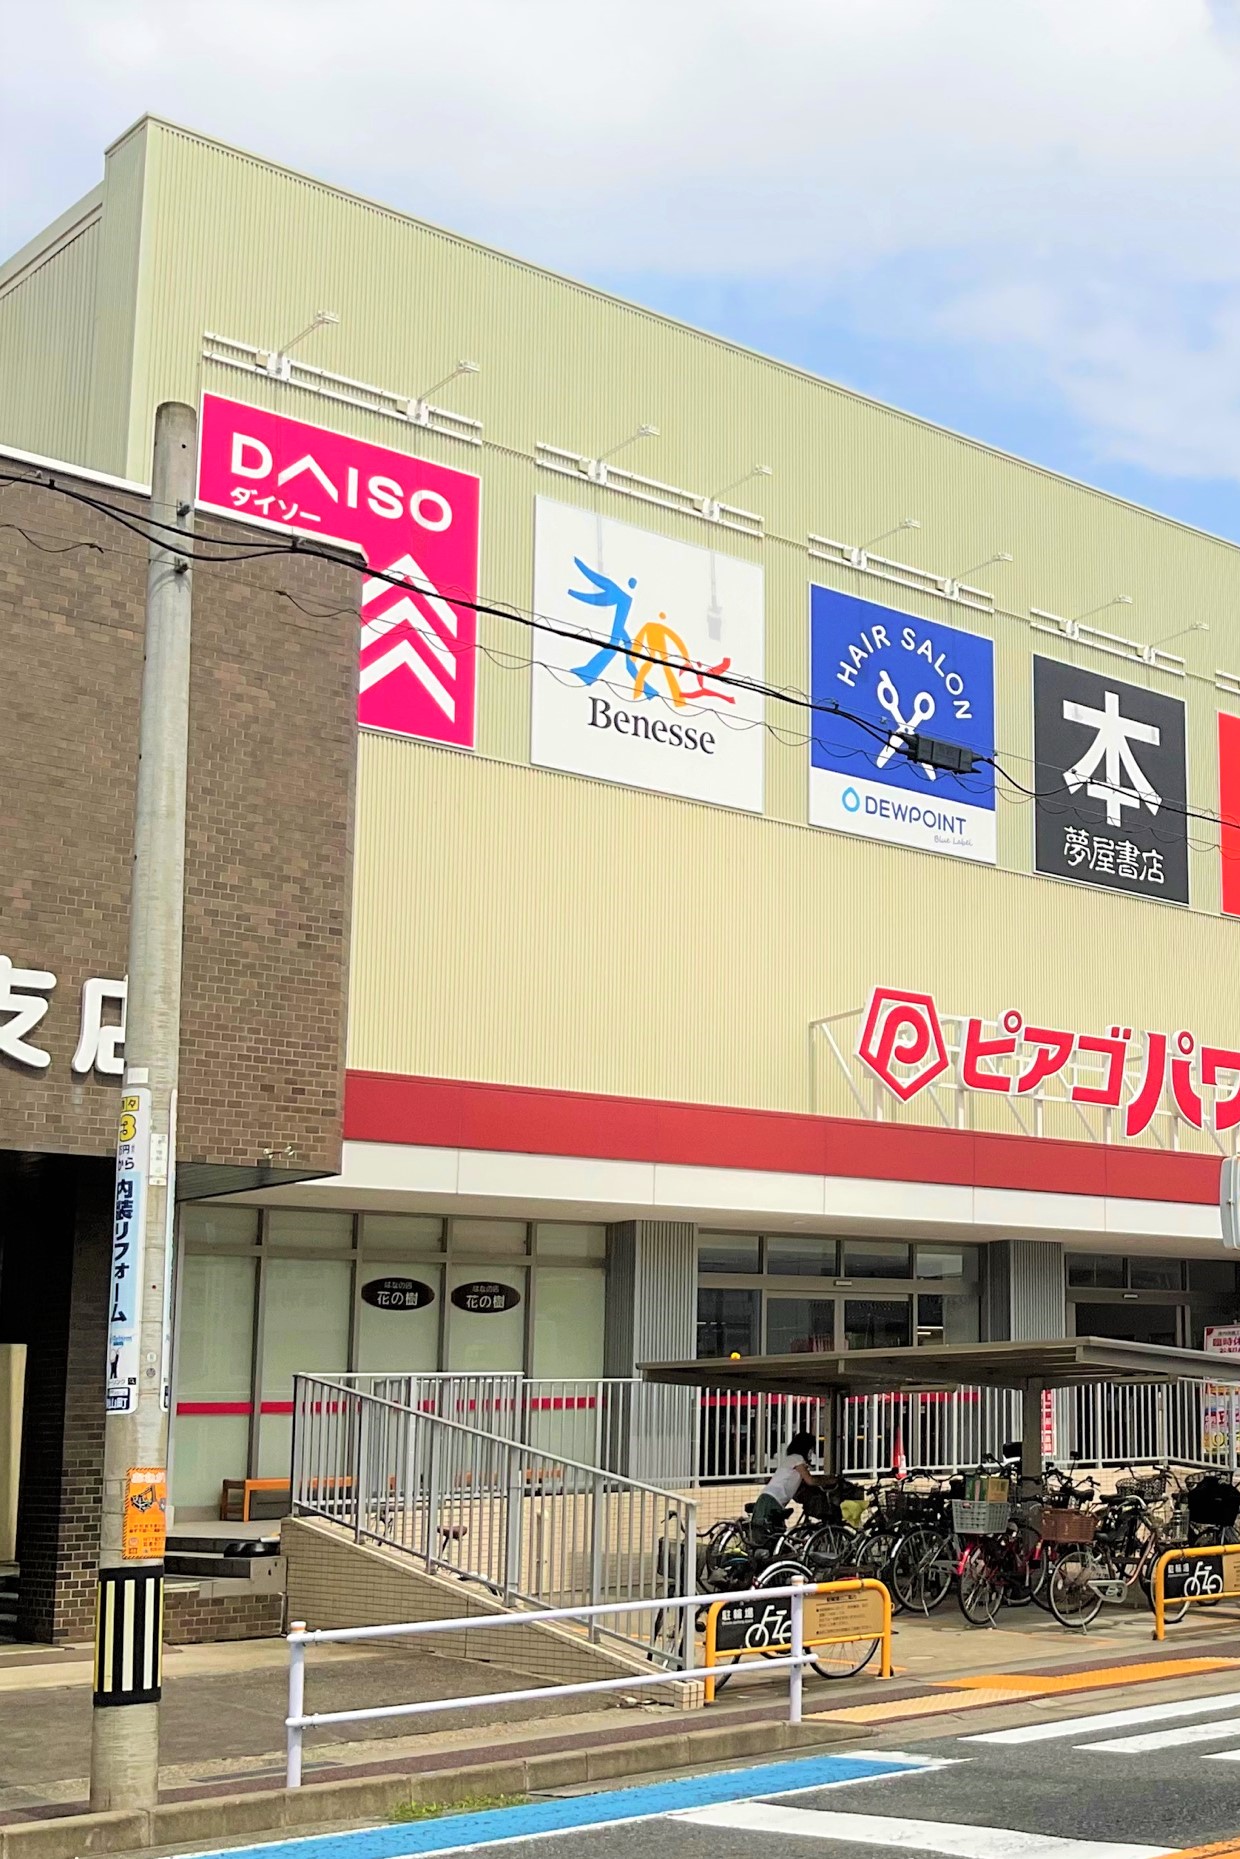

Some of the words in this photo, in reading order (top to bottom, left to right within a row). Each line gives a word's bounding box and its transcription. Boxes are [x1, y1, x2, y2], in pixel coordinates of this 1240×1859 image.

[230, 486, 321, 523] ダイソー
[836, 624, 891, 687] HAIR
[901, 627, 973, 719] SALON
[587, 696, 716, 755] Benesse
[1063, 690, 1162, 827] 本
[865, 795, 967, 835] DEWPOINT
[934, 835, 951, 845] Blue
[952, 836, 974, 847] Label
[1063, 826, 1165, 884] 夢屋書店
[111, 1178, 133, 1323] 内装リフォーム
[721, 1606, 754, 1621] 駐輪場
